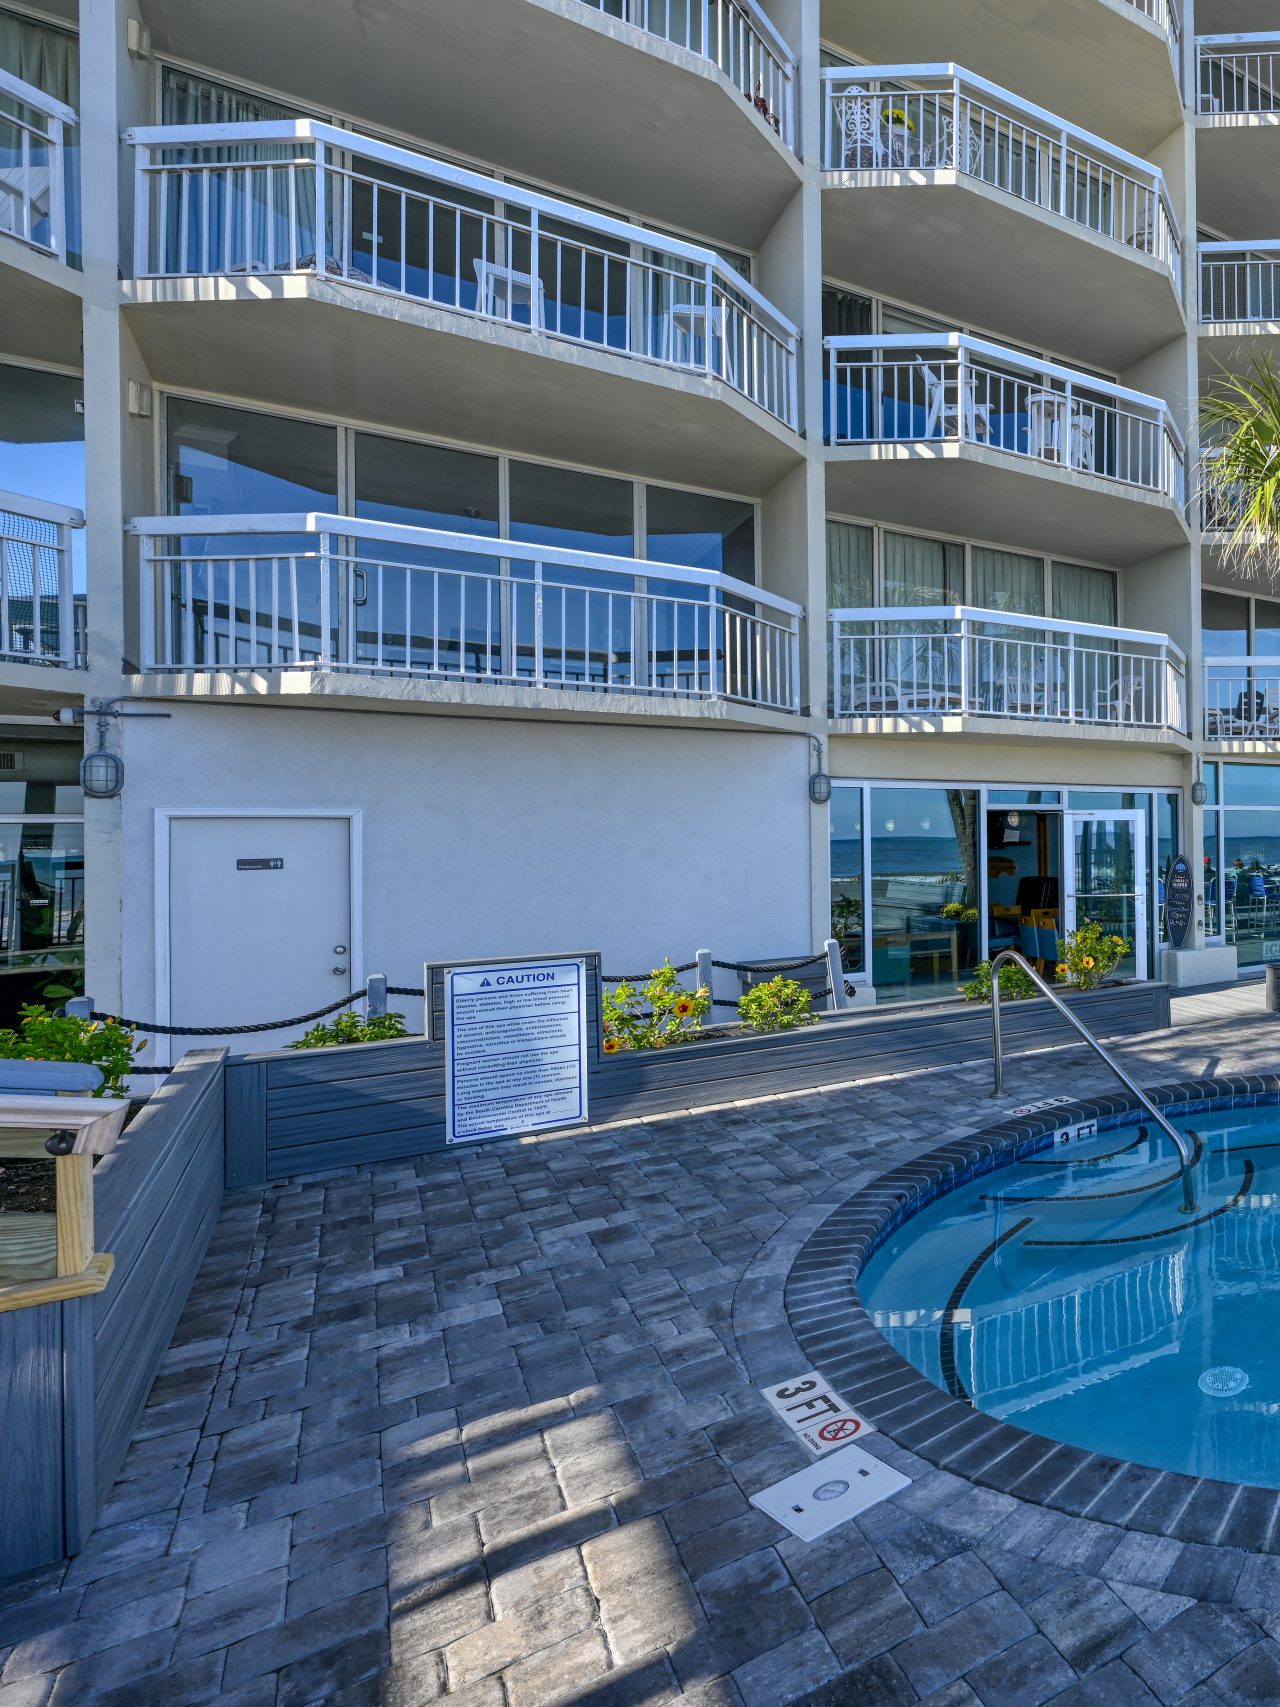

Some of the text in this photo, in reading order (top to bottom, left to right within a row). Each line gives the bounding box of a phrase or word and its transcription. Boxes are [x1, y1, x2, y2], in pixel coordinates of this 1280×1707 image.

[496, 971, 555, 985] CAUTION
[514, 1099, 543, 1108] Department
[776, 1380, 842, 1423] 3 FT
[808, 1438, 821, 1450] DIVING
